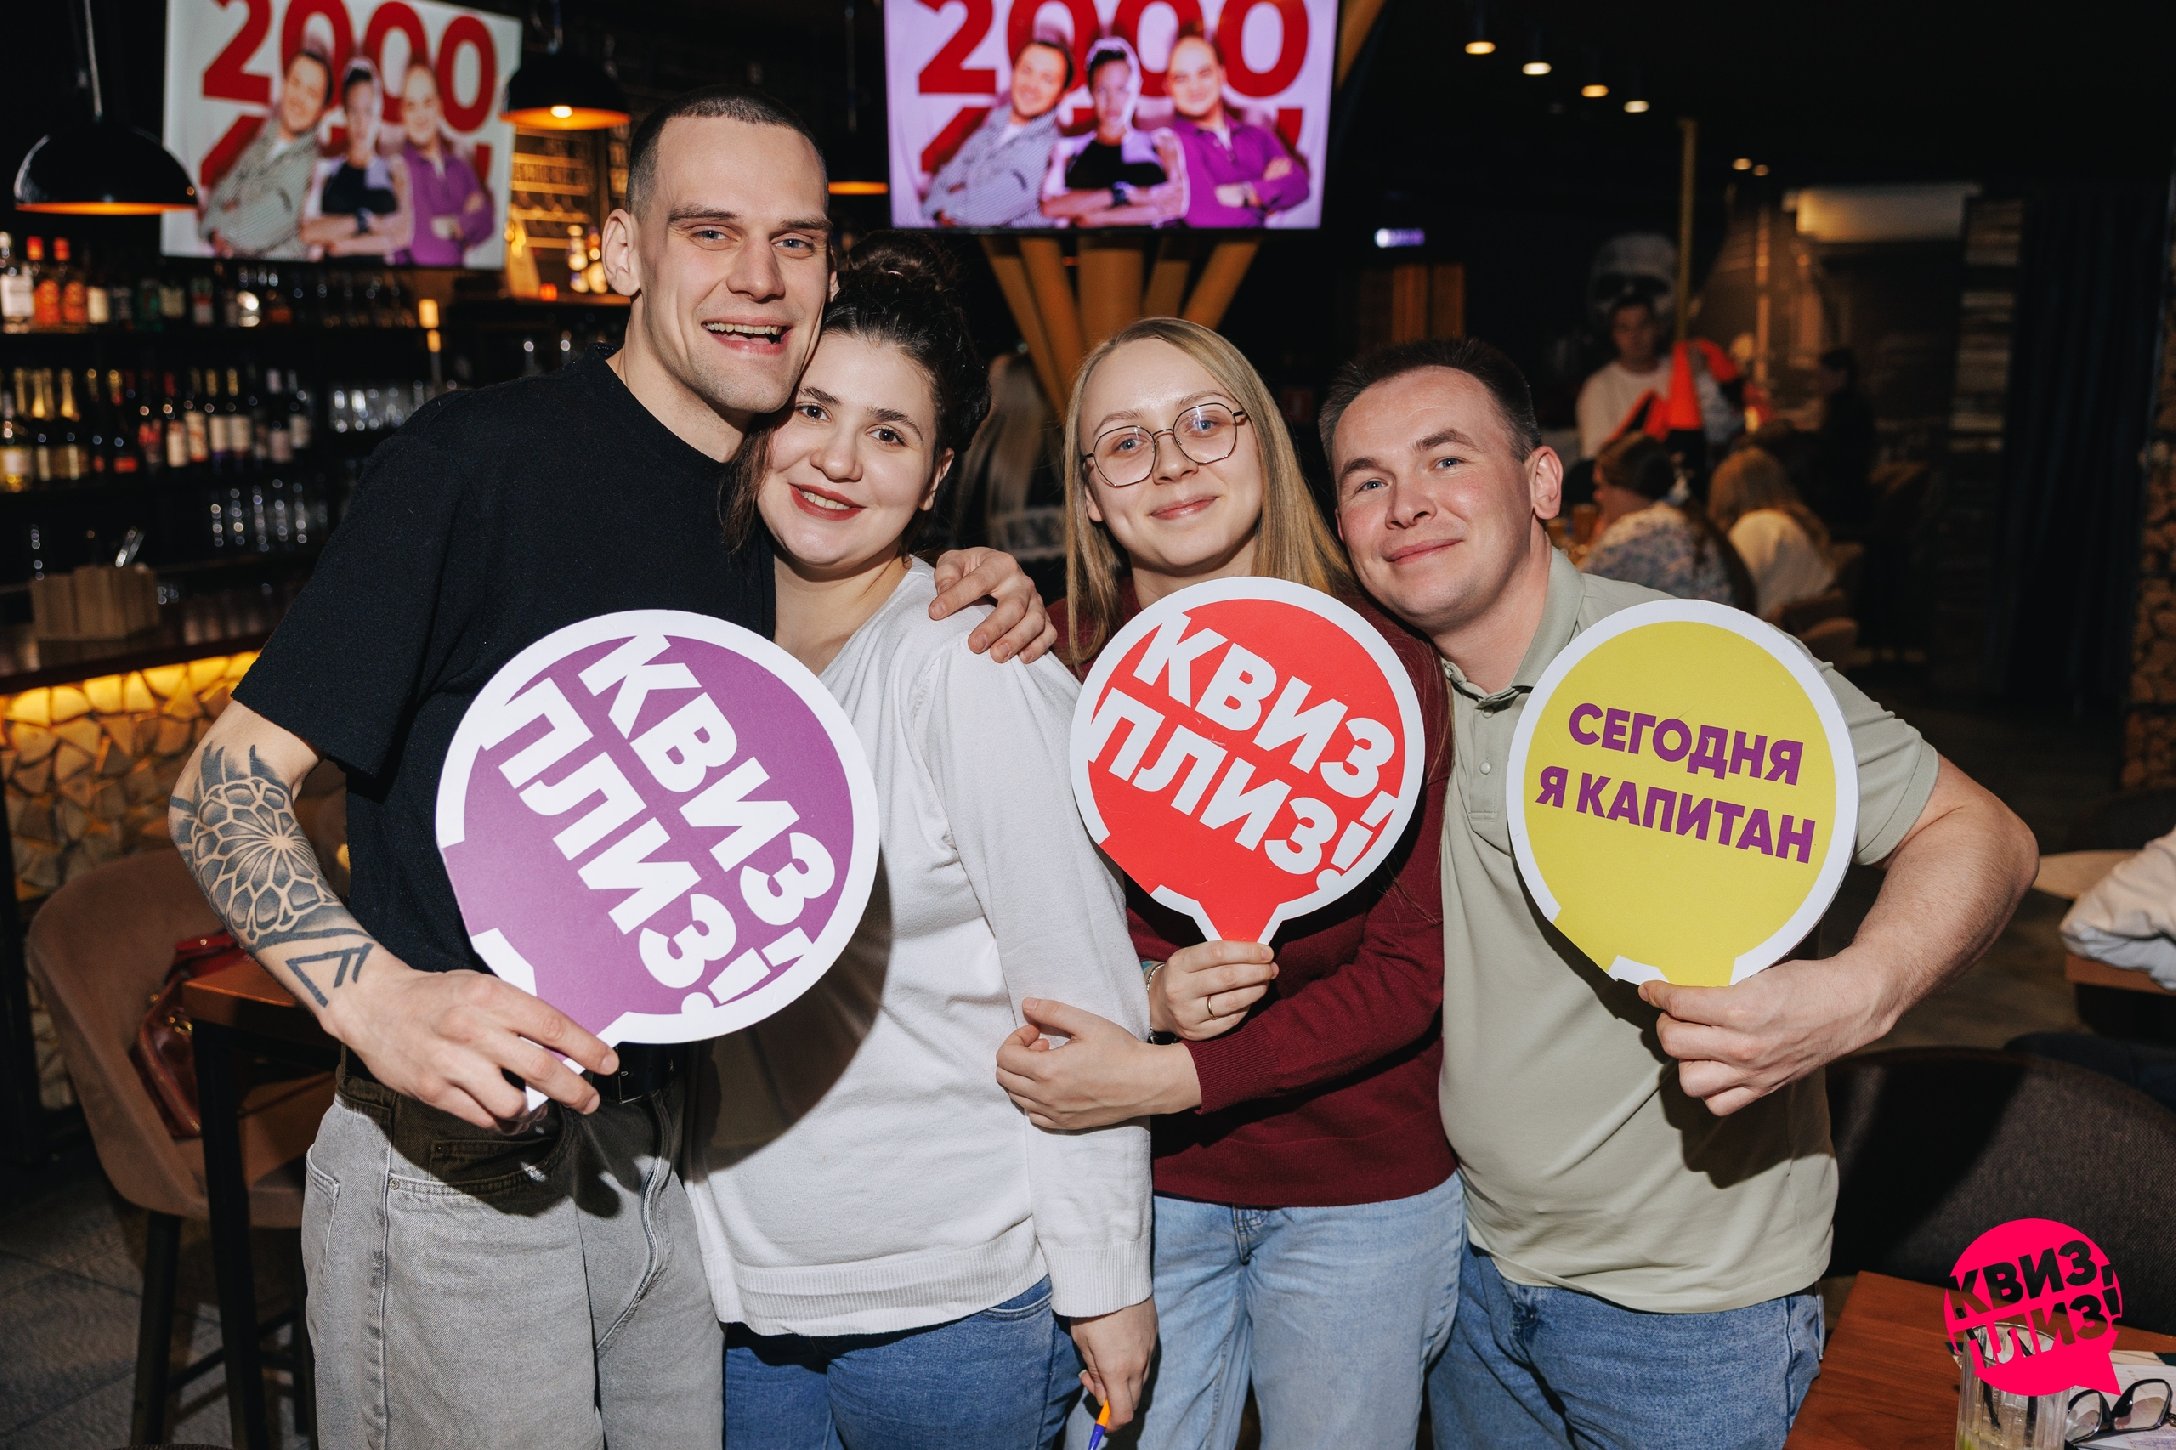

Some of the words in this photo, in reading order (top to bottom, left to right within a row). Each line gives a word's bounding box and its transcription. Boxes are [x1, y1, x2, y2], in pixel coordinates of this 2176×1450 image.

[1090, 686, 1374, 891] ПЛИЗ!
[1535, 765, 1569, 809] Я
[1576, 772, 1816, 864] КАПИТАН
[1568, 702, 1804, 787] СЕГОДНЯ
[480, 676, 773, 1018] ПЛИЗ!
